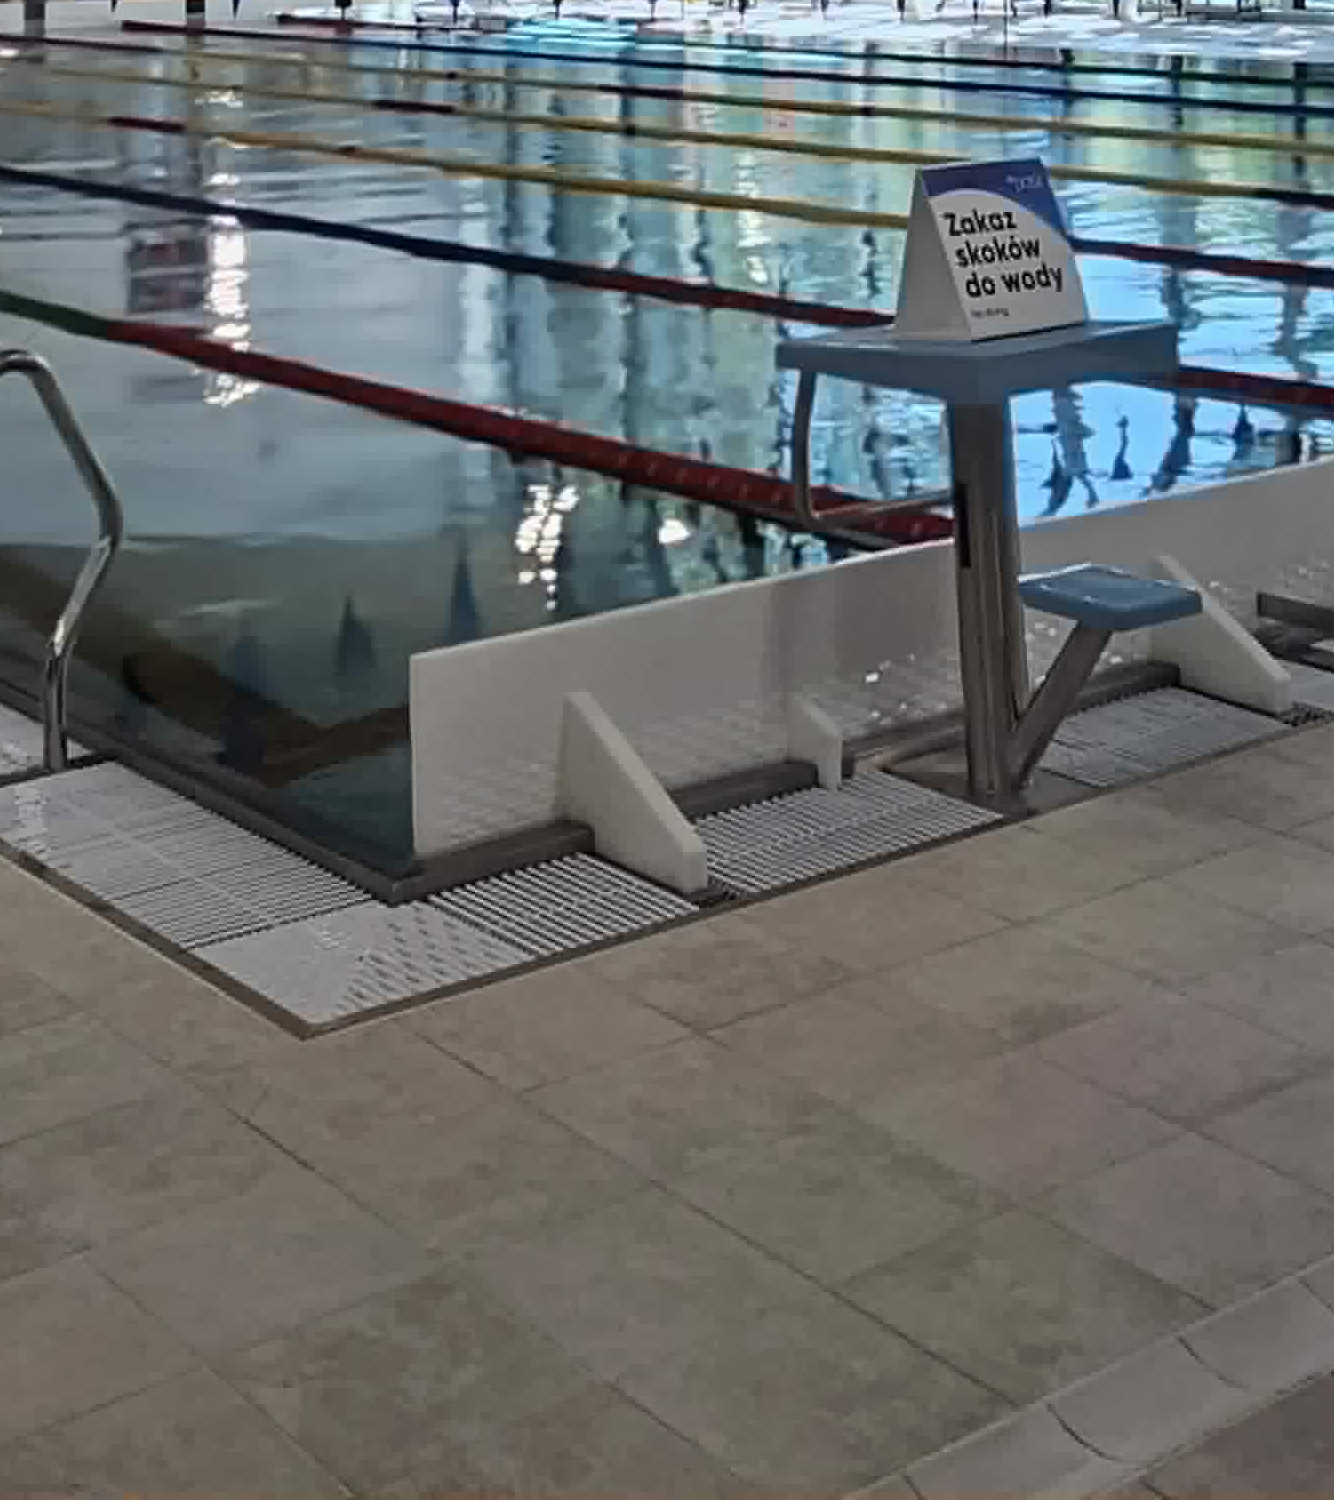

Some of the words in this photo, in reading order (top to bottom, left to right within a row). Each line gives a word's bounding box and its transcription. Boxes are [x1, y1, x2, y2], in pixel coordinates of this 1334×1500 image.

[943, 208, 1017, 236] Zakaz
[955, 236, 1039, 268] skoków
[966, 270, 996, 298] do
[1002, 263, 1063, 292] wody
